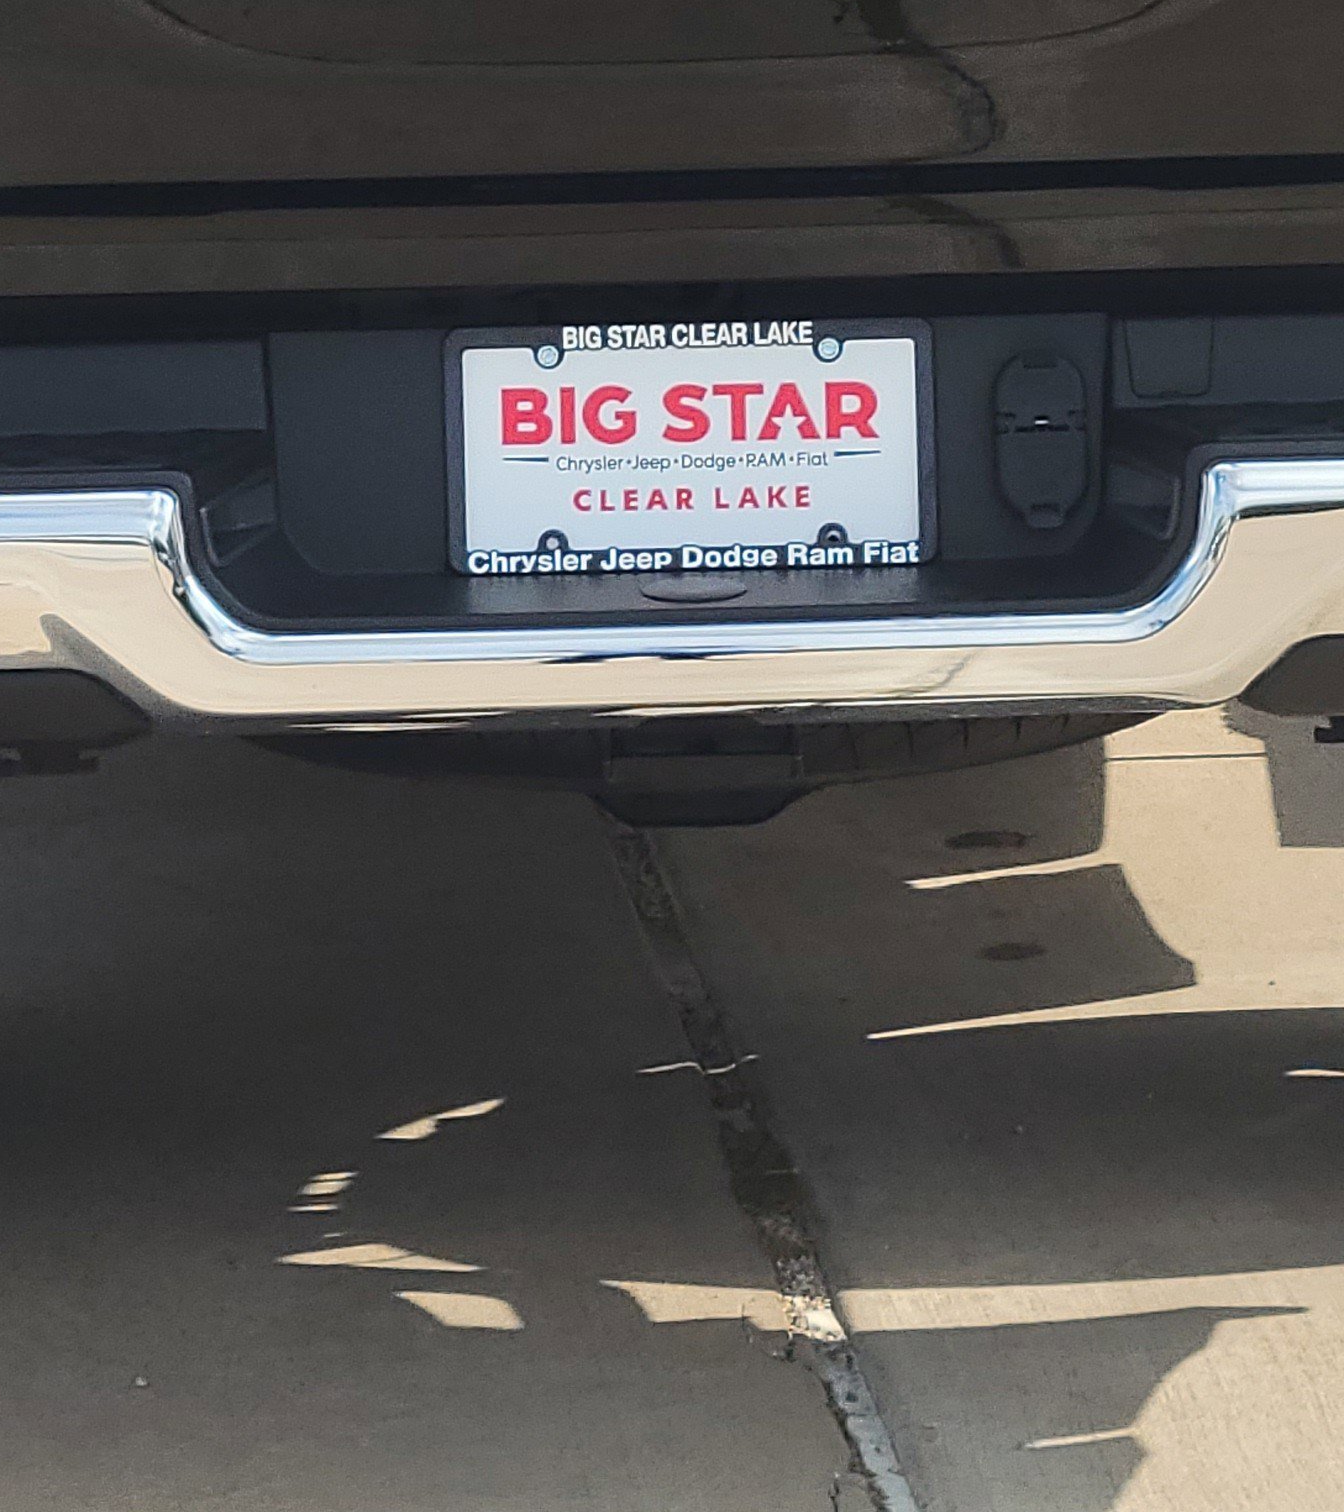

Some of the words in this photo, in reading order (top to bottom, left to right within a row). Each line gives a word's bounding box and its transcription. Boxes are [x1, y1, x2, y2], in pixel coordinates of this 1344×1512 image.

[562, 325, 602, 349] BIG
[607, 324, 666, 348] STAR
[671, 322, 748, 347] CLEAR
[754, 321, 814, 345] LAKE
[500, 384, 637, 445] BIG
[662, 381, 880, 443] STAR
[572, 487, 695, 512] CLEAR
[714, 485, 811, 510] LAKE
[467, 550, 592, 575] Chrysler
[600, 548, 673, 572] Jeep
[682, 544, 778, 569] Dodge
[787, 543, 854, 566] Ram
[863, 541, 920, 565] Fiat
